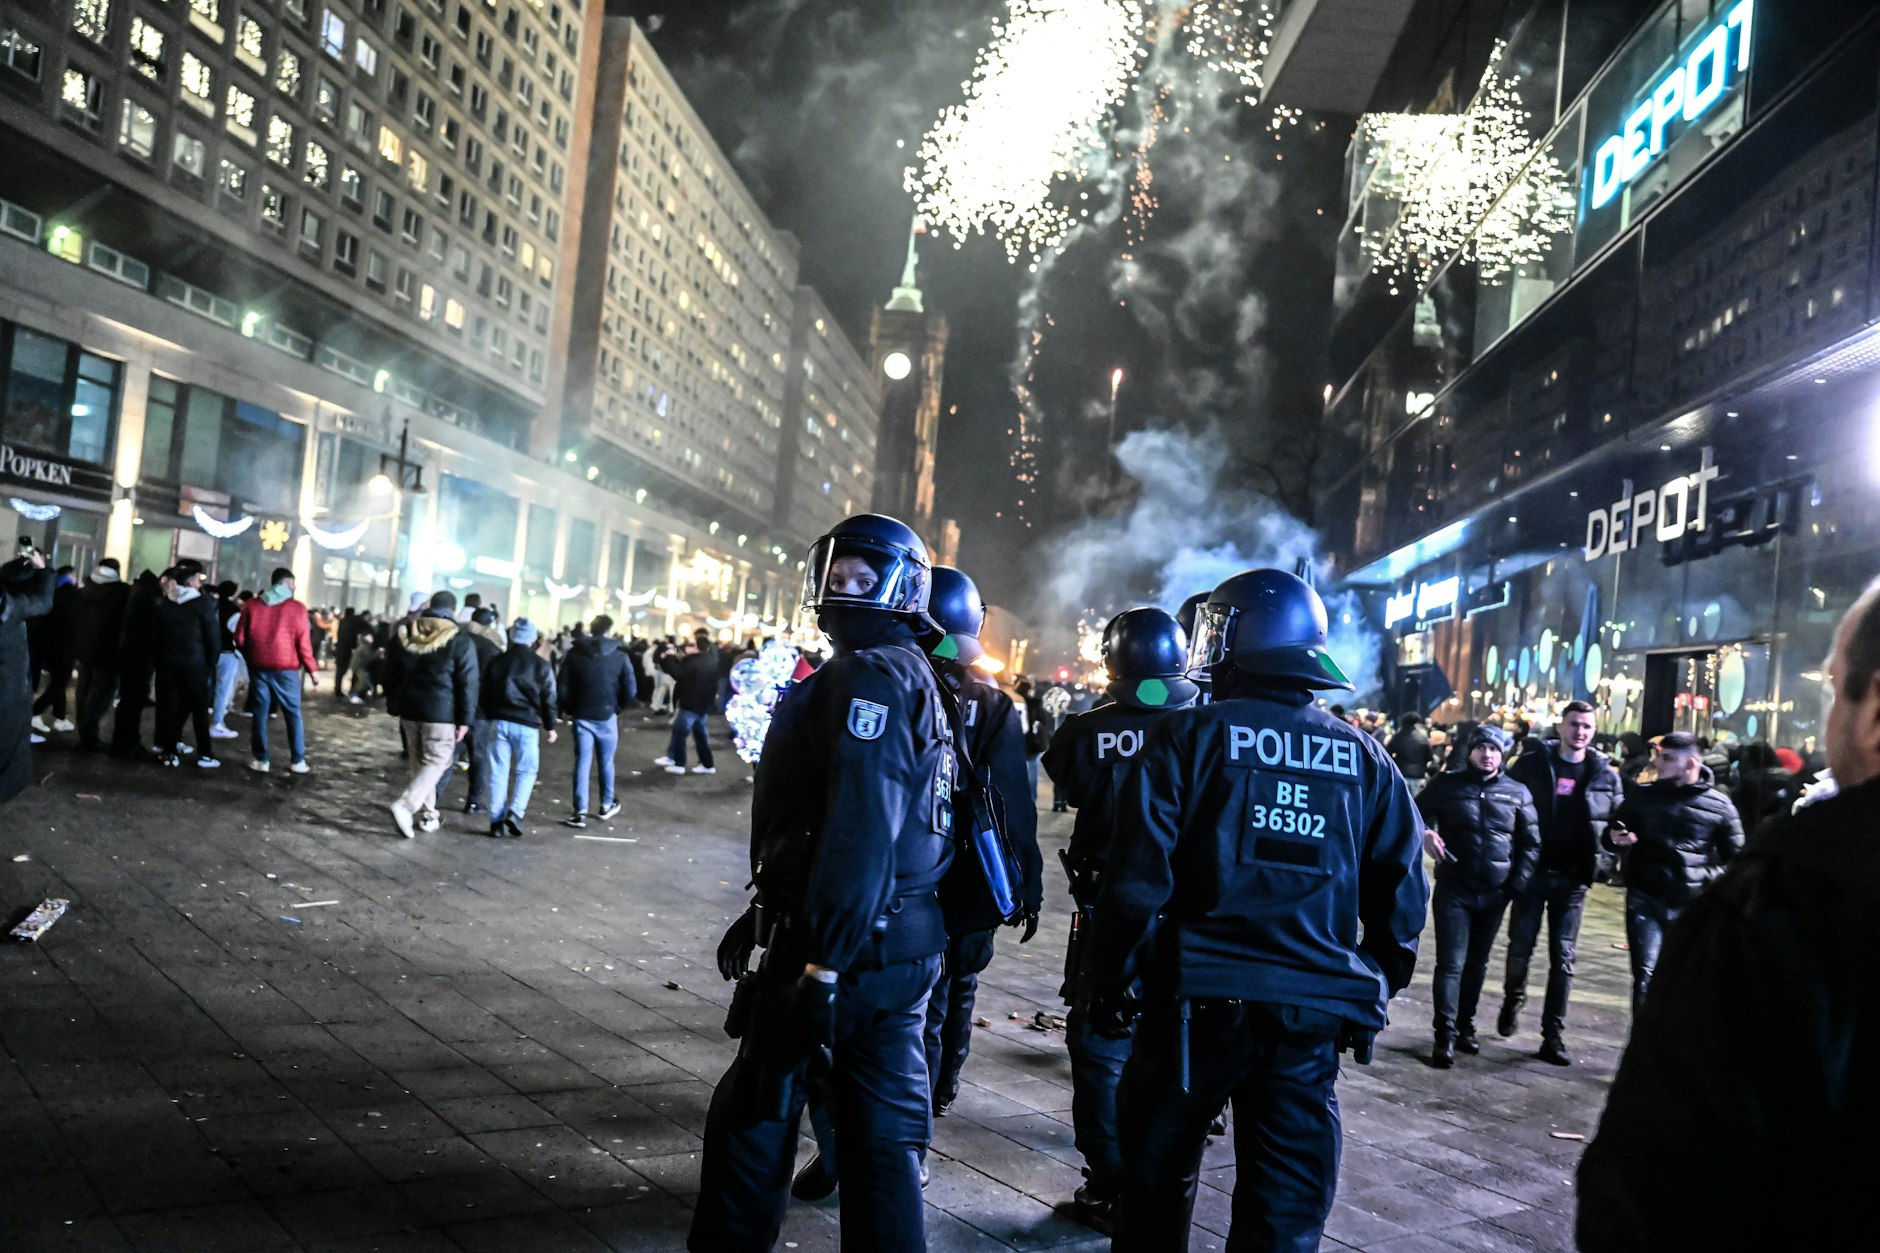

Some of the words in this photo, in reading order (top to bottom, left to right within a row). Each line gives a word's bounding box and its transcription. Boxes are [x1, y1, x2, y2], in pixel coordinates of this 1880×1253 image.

[1592, 0, 1753, 210] DEPOT
[1229, 725, 1358, 777] POLIZEI
[1276, 780, 1309, 809] BE
[1252, 804, 1326, 838] 36302
